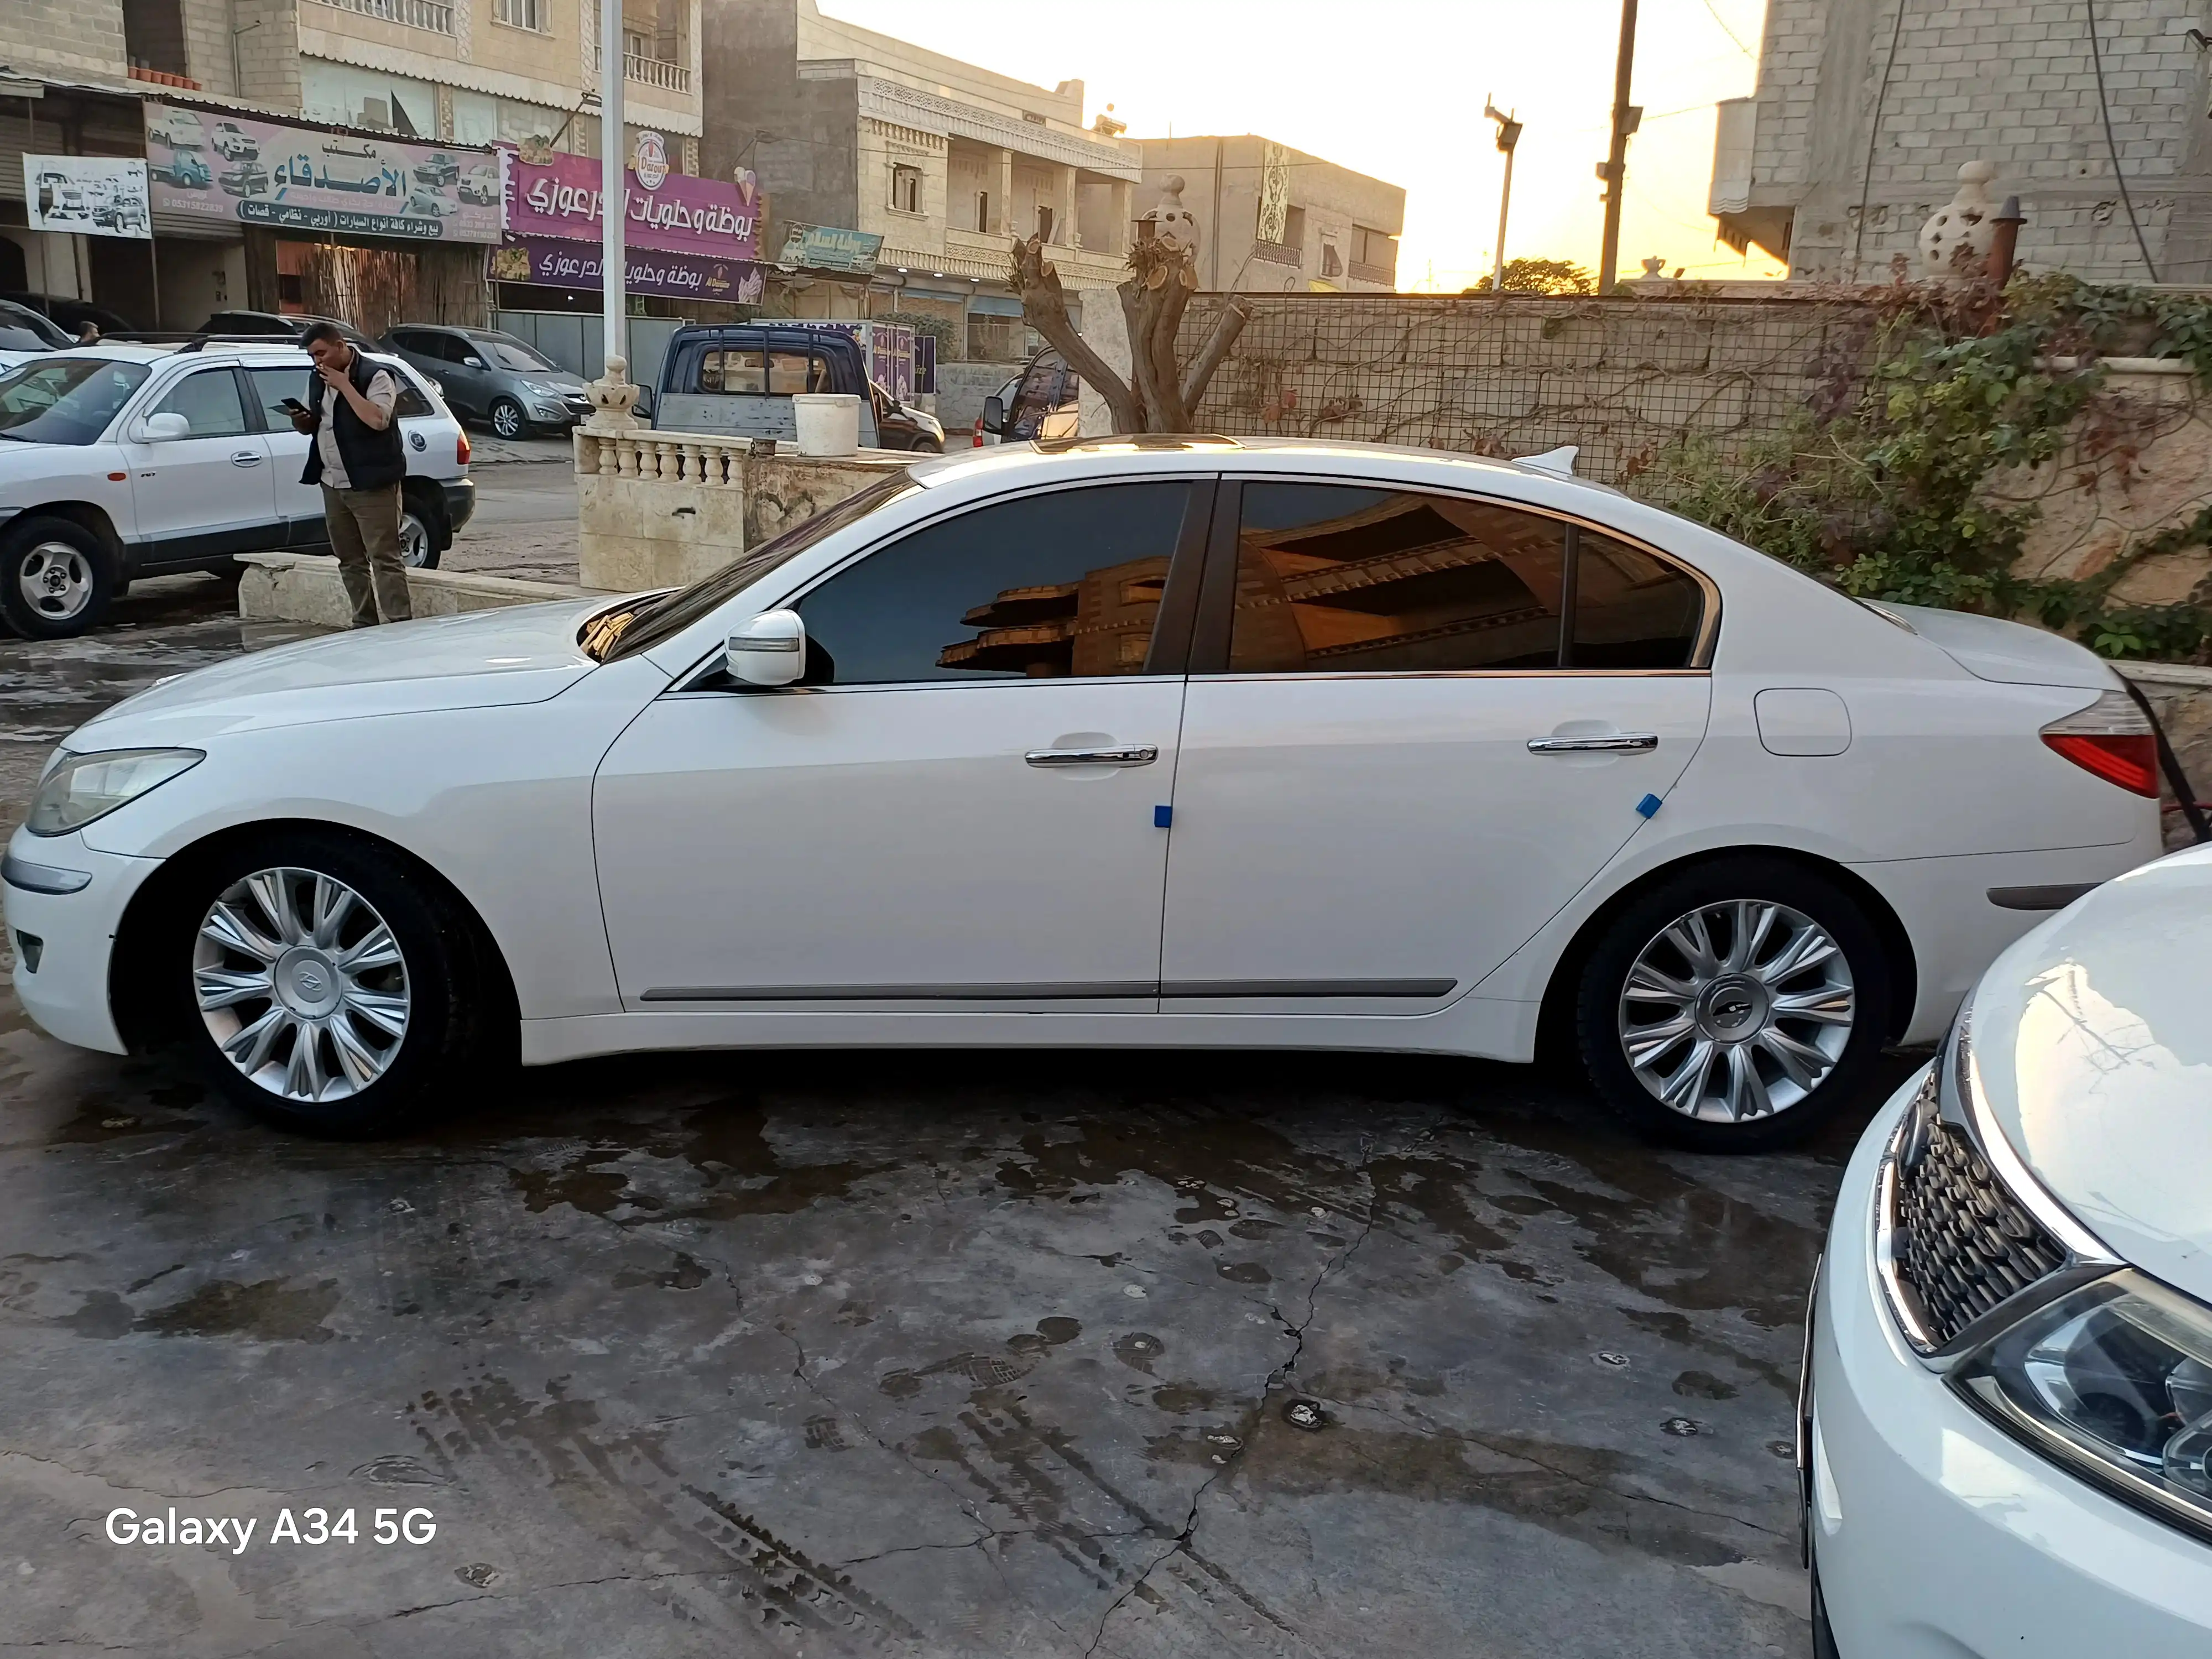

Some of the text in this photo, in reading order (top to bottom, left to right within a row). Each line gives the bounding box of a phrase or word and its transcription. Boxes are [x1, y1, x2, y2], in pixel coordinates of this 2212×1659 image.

[322, 139, 376, 159] مكتب
[274, 153, 407, 196] الأصدقاء
[248, 204, 269, 217] قصات
[279, 208, 302, 223] نظامي
[340, 215, 369, 229] السيارات
[372, 217, 388, 231] أنواع
[390, 218, 405, 230] كافة
[407, 221, 427, 235] وشراء
[706, 204, 753, 242] بوظة
[429, 225, 439, 236] بيع
[667, 265, 703, 291] بوظة
